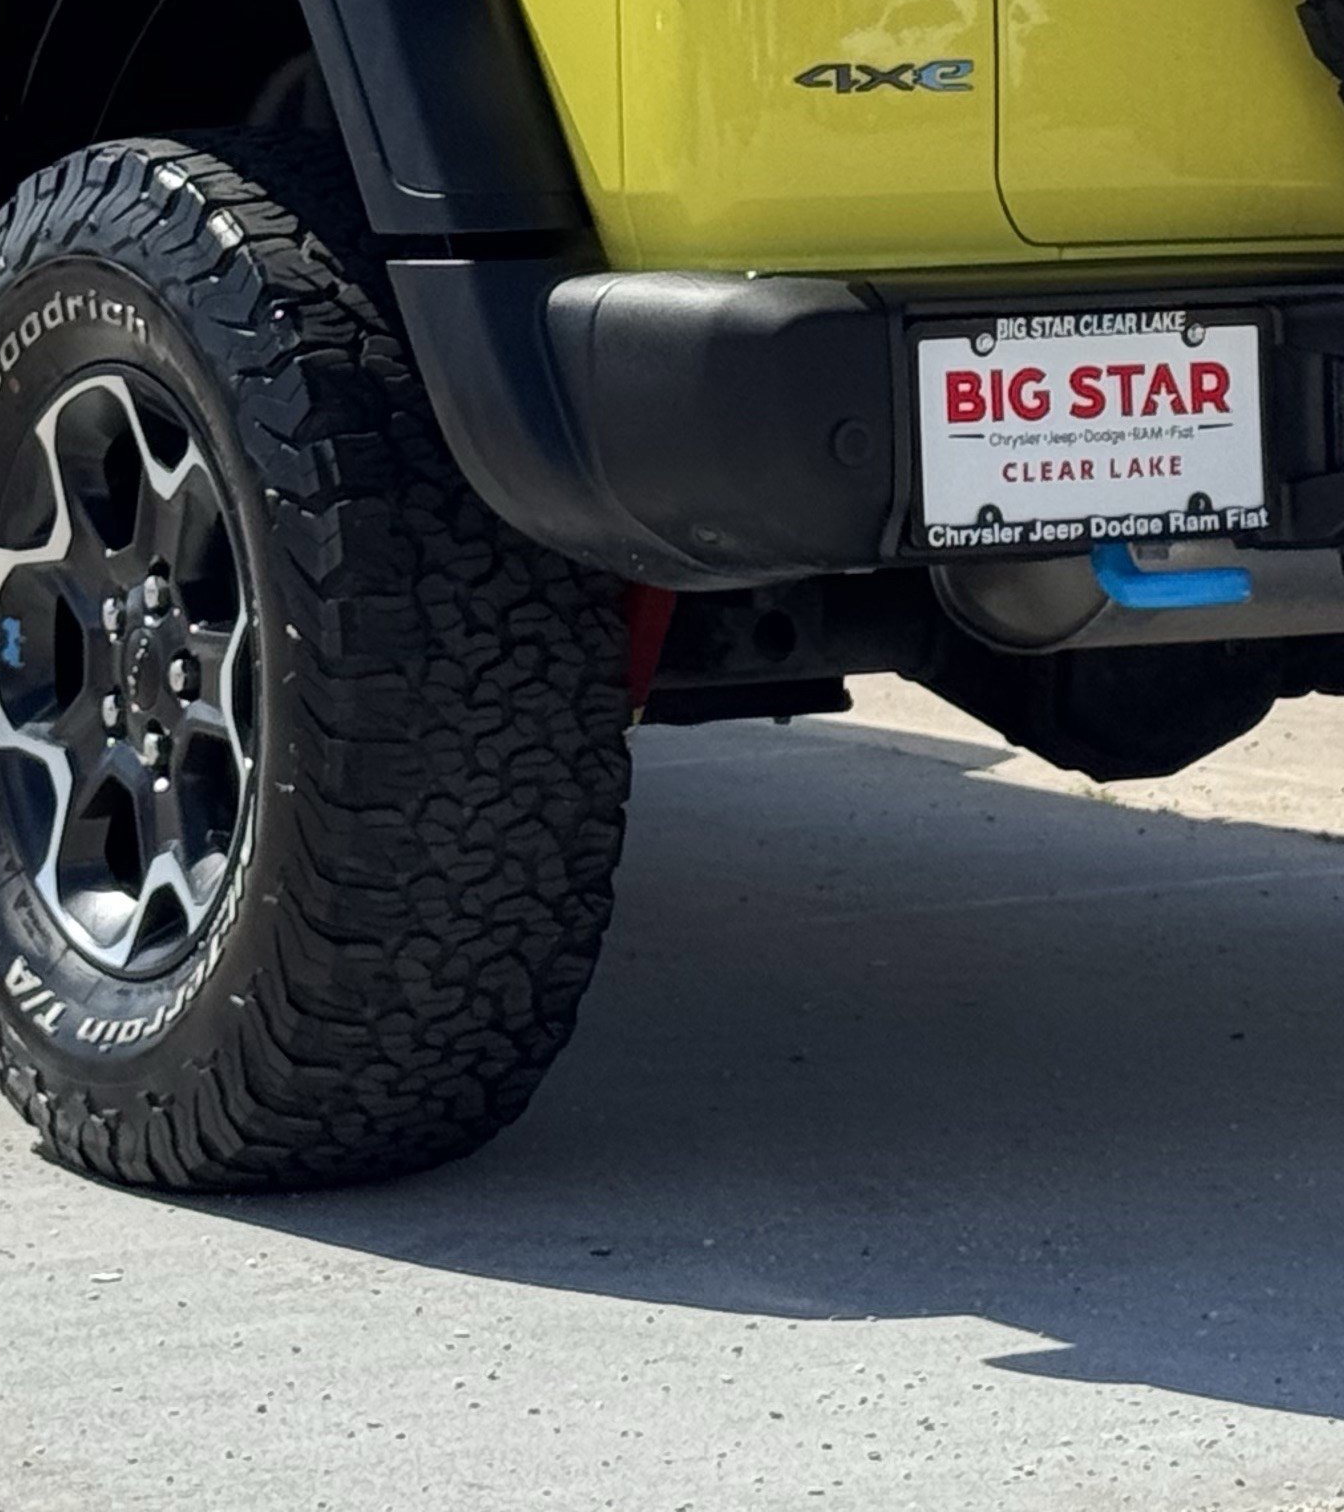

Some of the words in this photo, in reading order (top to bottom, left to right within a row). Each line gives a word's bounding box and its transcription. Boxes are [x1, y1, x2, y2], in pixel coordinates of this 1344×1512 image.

[996, 316, 1027, 339] BIG
[1030, 315, 1076, 338] STAR
[1080, 312, 1137, 336] CLEAR
[1140, 310, 1187, 333] LAKE
[945, 366, 1051, 424] BIG
[1069, 361, 1231, 419] STAR
[1002, 458, 1095, 482] CLEAR
[1109, 455, 1183, 479] LAKE
[928, 523, 1024, 548] Chrysler
[1029, 520, 1084, 543] Jeep
[1090, 515, 1164, 538] Dodge
[1169, 510, 1221, 533] Ram
[1226, 506, 1269, 529] Fiat
[4, 954, 67, 1034] T/A
